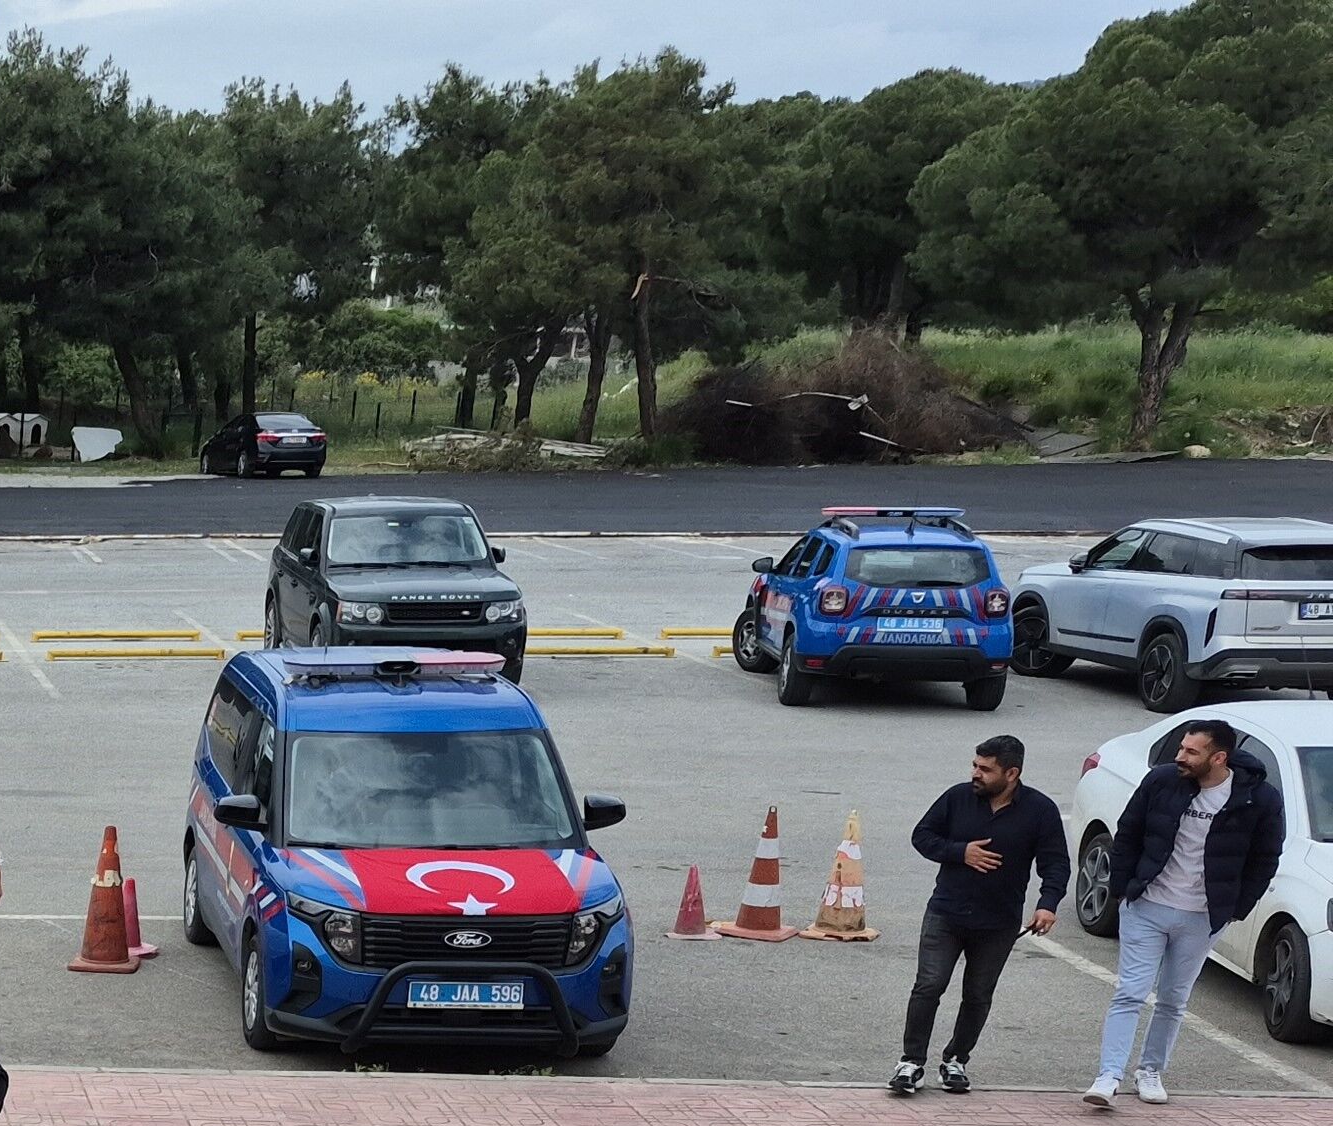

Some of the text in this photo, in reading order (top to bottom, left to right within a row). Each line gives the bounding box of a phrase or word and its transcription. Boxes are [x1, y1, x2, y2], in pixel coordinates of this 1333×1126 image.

[881, 633, 943, 644] JANDARMA
[1183, 808, 1214, 821] RBER
[453, 932, 483, 945] Ford
[420, 984, 521, 1002] 48 JAA 596
